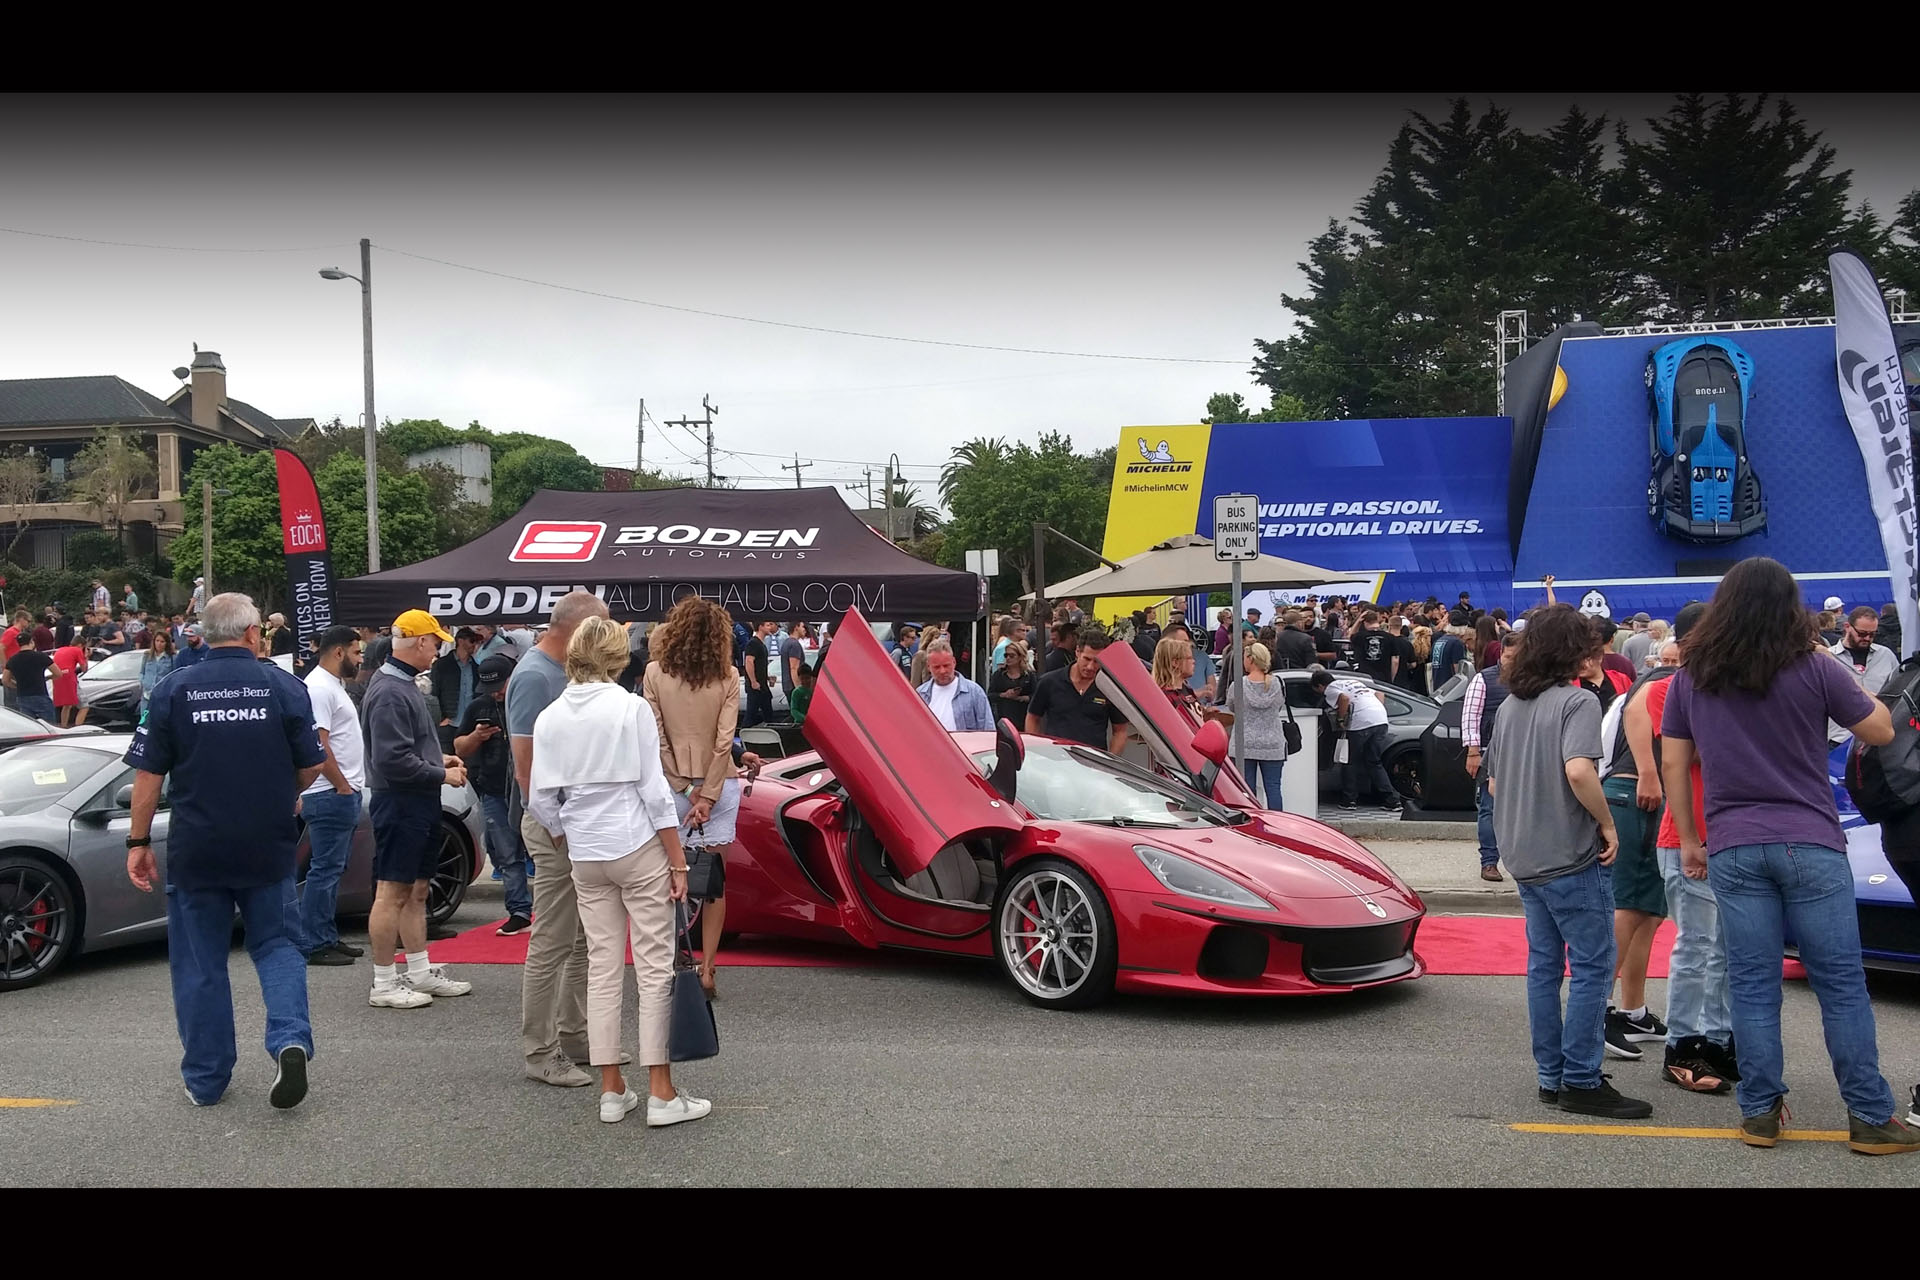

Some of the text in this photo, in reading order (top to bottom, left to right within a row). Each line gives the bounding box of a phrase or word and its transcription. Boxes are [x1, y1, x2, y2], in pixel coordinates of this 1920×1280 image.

[1126, 464, 1192, 474] MICHELIN
[1124, 483, 1189, 493] #MichelinMCW
[1227, 508, 1246, 518] BUS
[1259, 501, 1443, 517] NUINE PASSION.
[1218, 522, 1256, 533] PARKING
[1388, 520, 1484, 534] DRIVES.
[290, 524, 322, 546] EOCR
[614, 525, 820, 547] BODEN
[1225, 537, 1248, 548] ONLY
[613, 549, 806, 560] AUTOHAUS
[296, 583, 310, 602] ON
[309, 560, 332, 632] NERY ROW
[186, 687, 271, 702] Mercedes-Benz
[192, 707, 267, 724] PETRONAS
